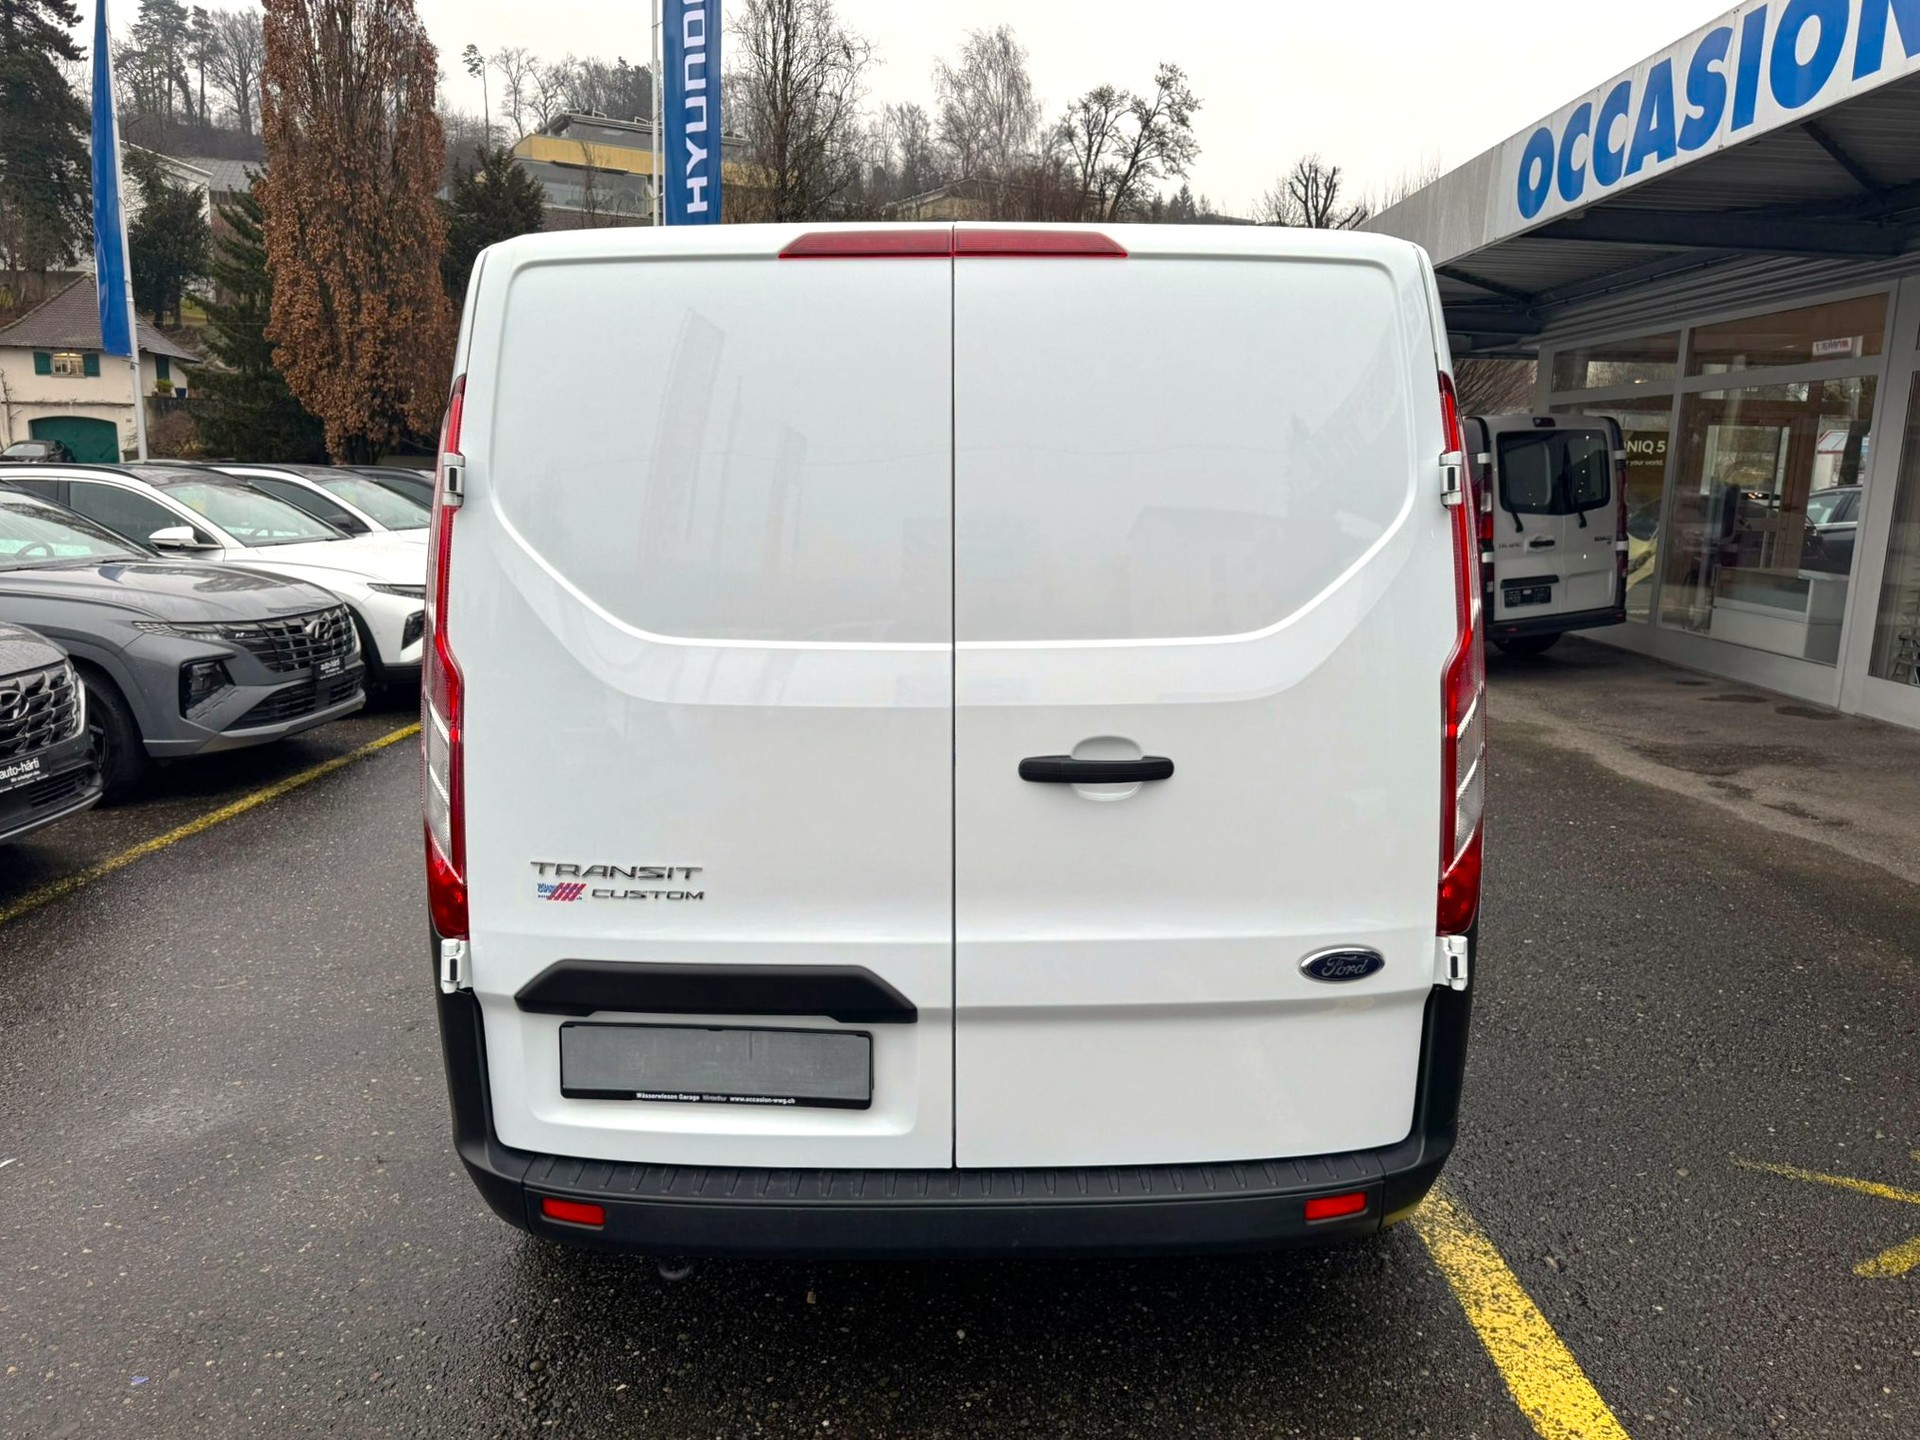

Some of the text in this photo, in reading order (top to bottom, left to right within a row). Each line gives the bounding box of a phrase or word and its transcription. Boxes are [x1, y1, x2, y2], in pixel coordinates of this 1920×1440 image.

[683, 0, 708, 214] HYUND
[1656, 440, 1666, 453] 5
[0, 757, 40, 780] auto-härti
[530, 861, 703, 881] TRANSIT
[592, 888, 704, 901] CUSTOM
[1321, 955, 1368, 976] Ford
[636, 1092, 678, 1100] Wässerwiesen
[678, 1093, 700, 1102] Garage
